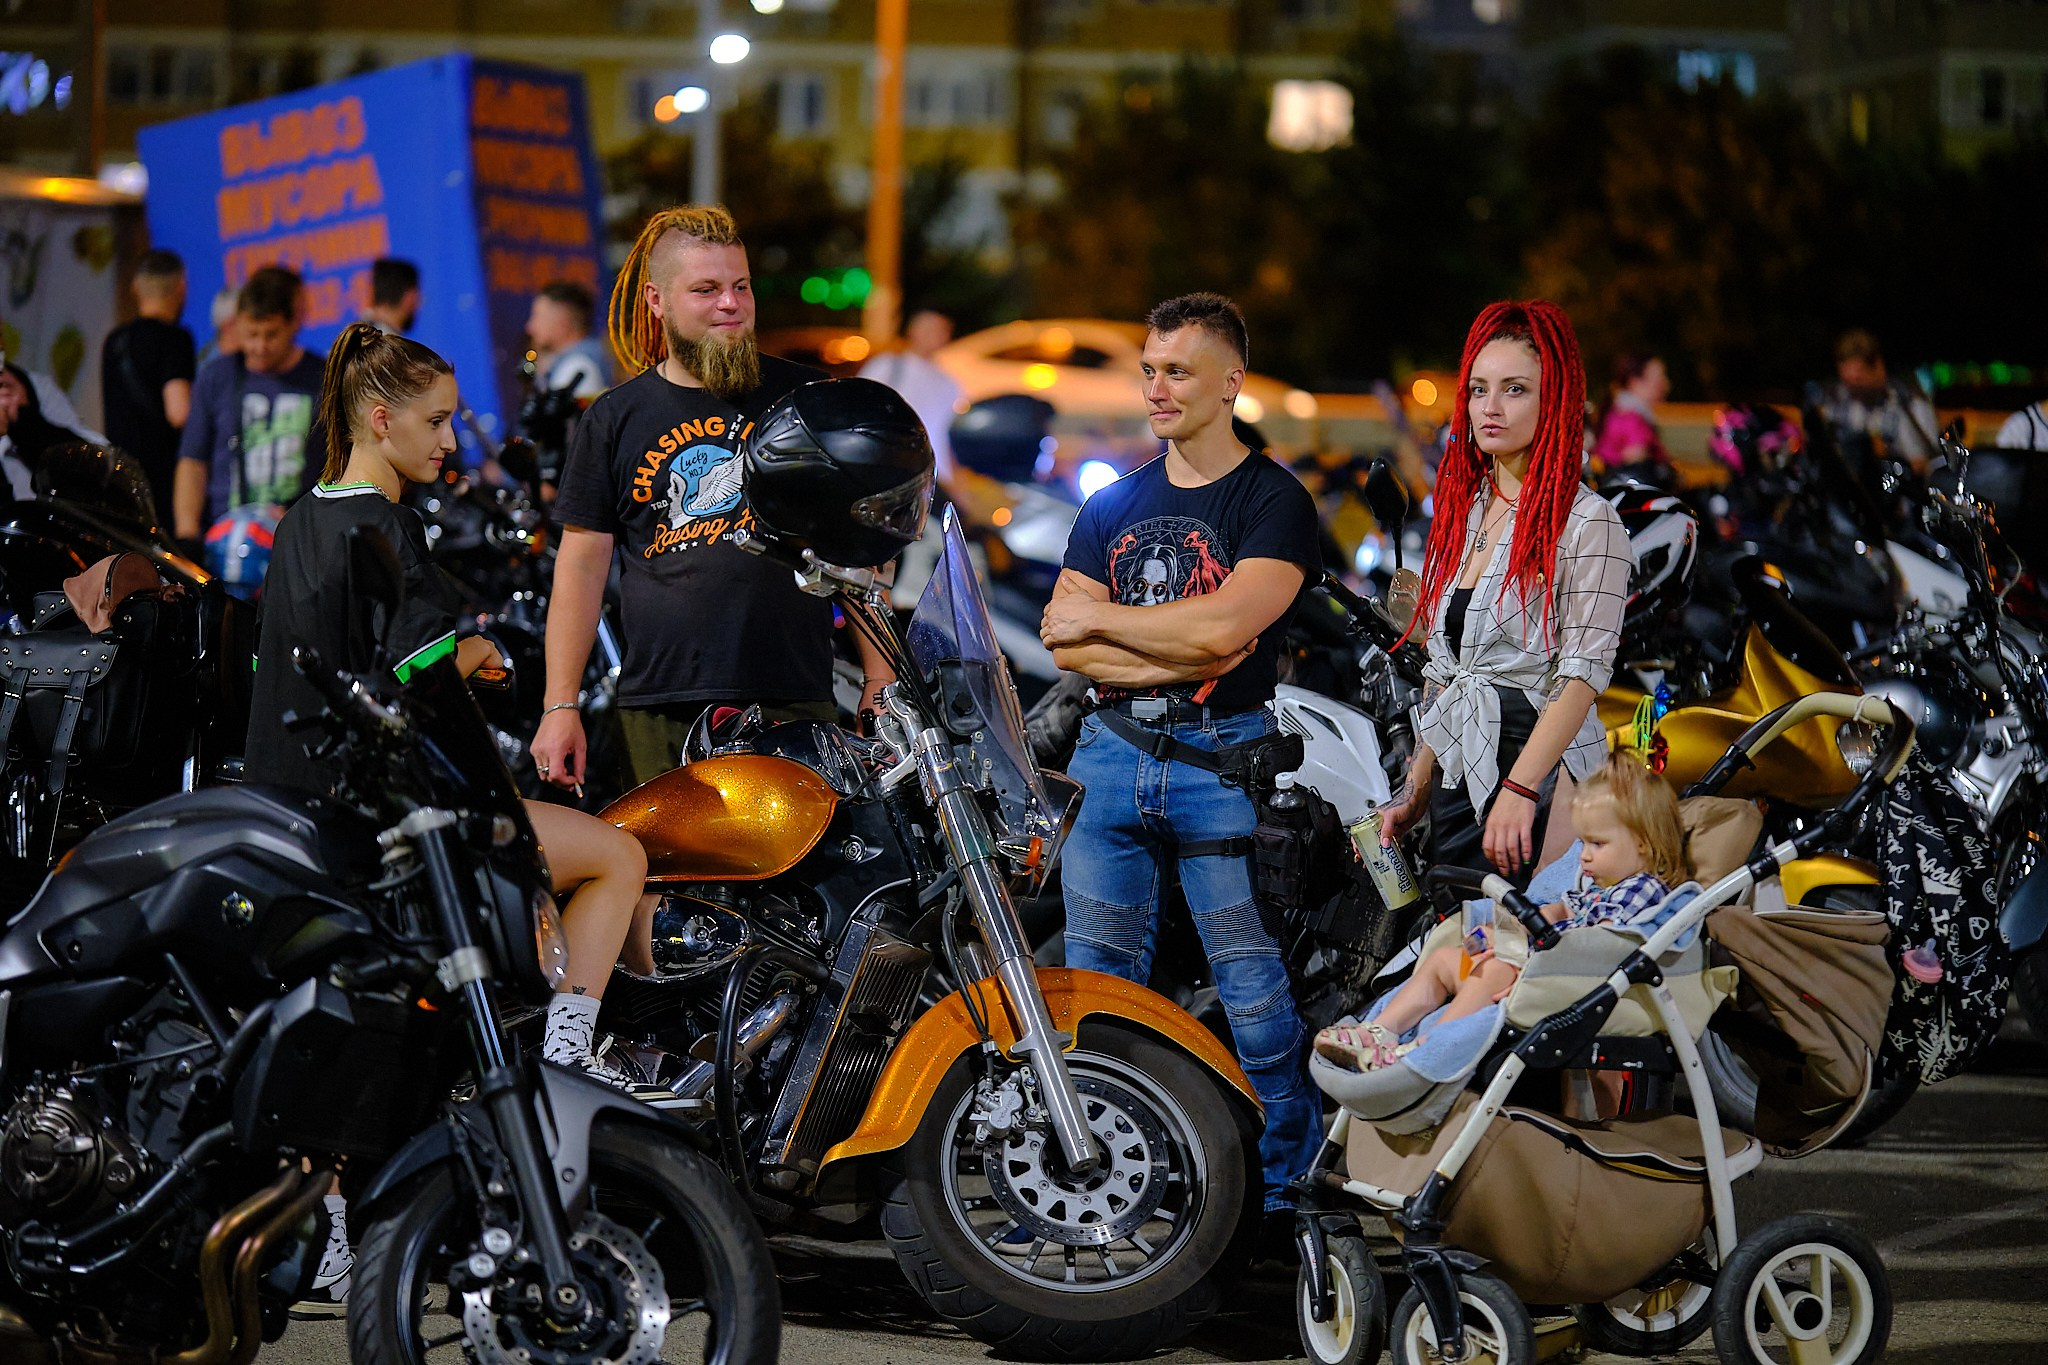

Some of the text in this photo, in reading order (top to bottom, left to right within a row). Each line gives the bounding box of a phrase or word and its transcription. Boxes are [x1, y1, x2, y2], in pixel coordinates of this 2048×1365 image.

[632, 413, 744, 503] CHASING THE
[680, 449, 708, 472] Lucky
[644, 517, 730, 558] Raising
